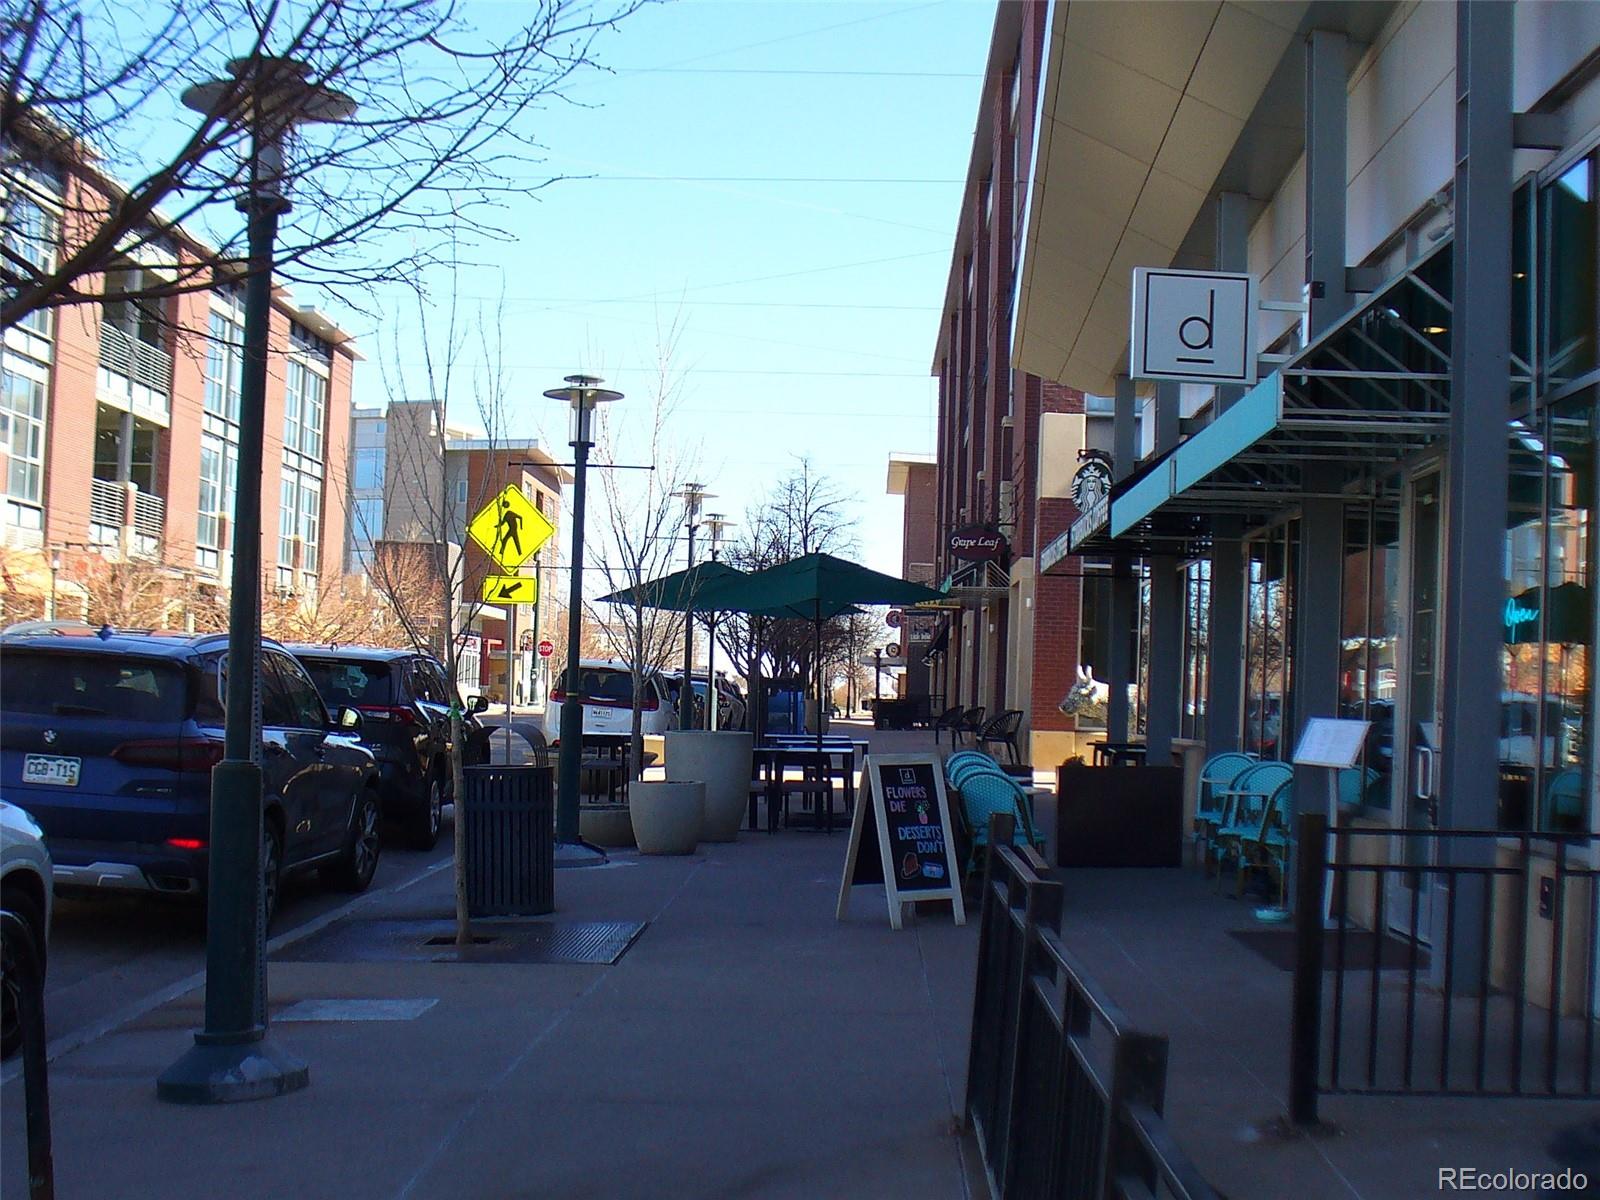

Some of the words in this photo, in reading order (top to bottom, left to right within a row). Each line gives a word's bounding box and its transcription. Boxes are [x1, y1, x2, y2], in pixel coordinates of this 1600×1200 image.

[1179, 289, 1214, 350] d
[951, 536, 976, 549] Grape
[978, 536, 1000, 550] Leaf
[1504, 597, 1539, 643] Open
[539, 645, 552, 653] STOP
[886, 786, 927, 800] FLOWERS
[890, 800, 907, 813] DIE
[898, 826, 942, 840] DESSERTS
[917, 840, 944, 854] DON'T
